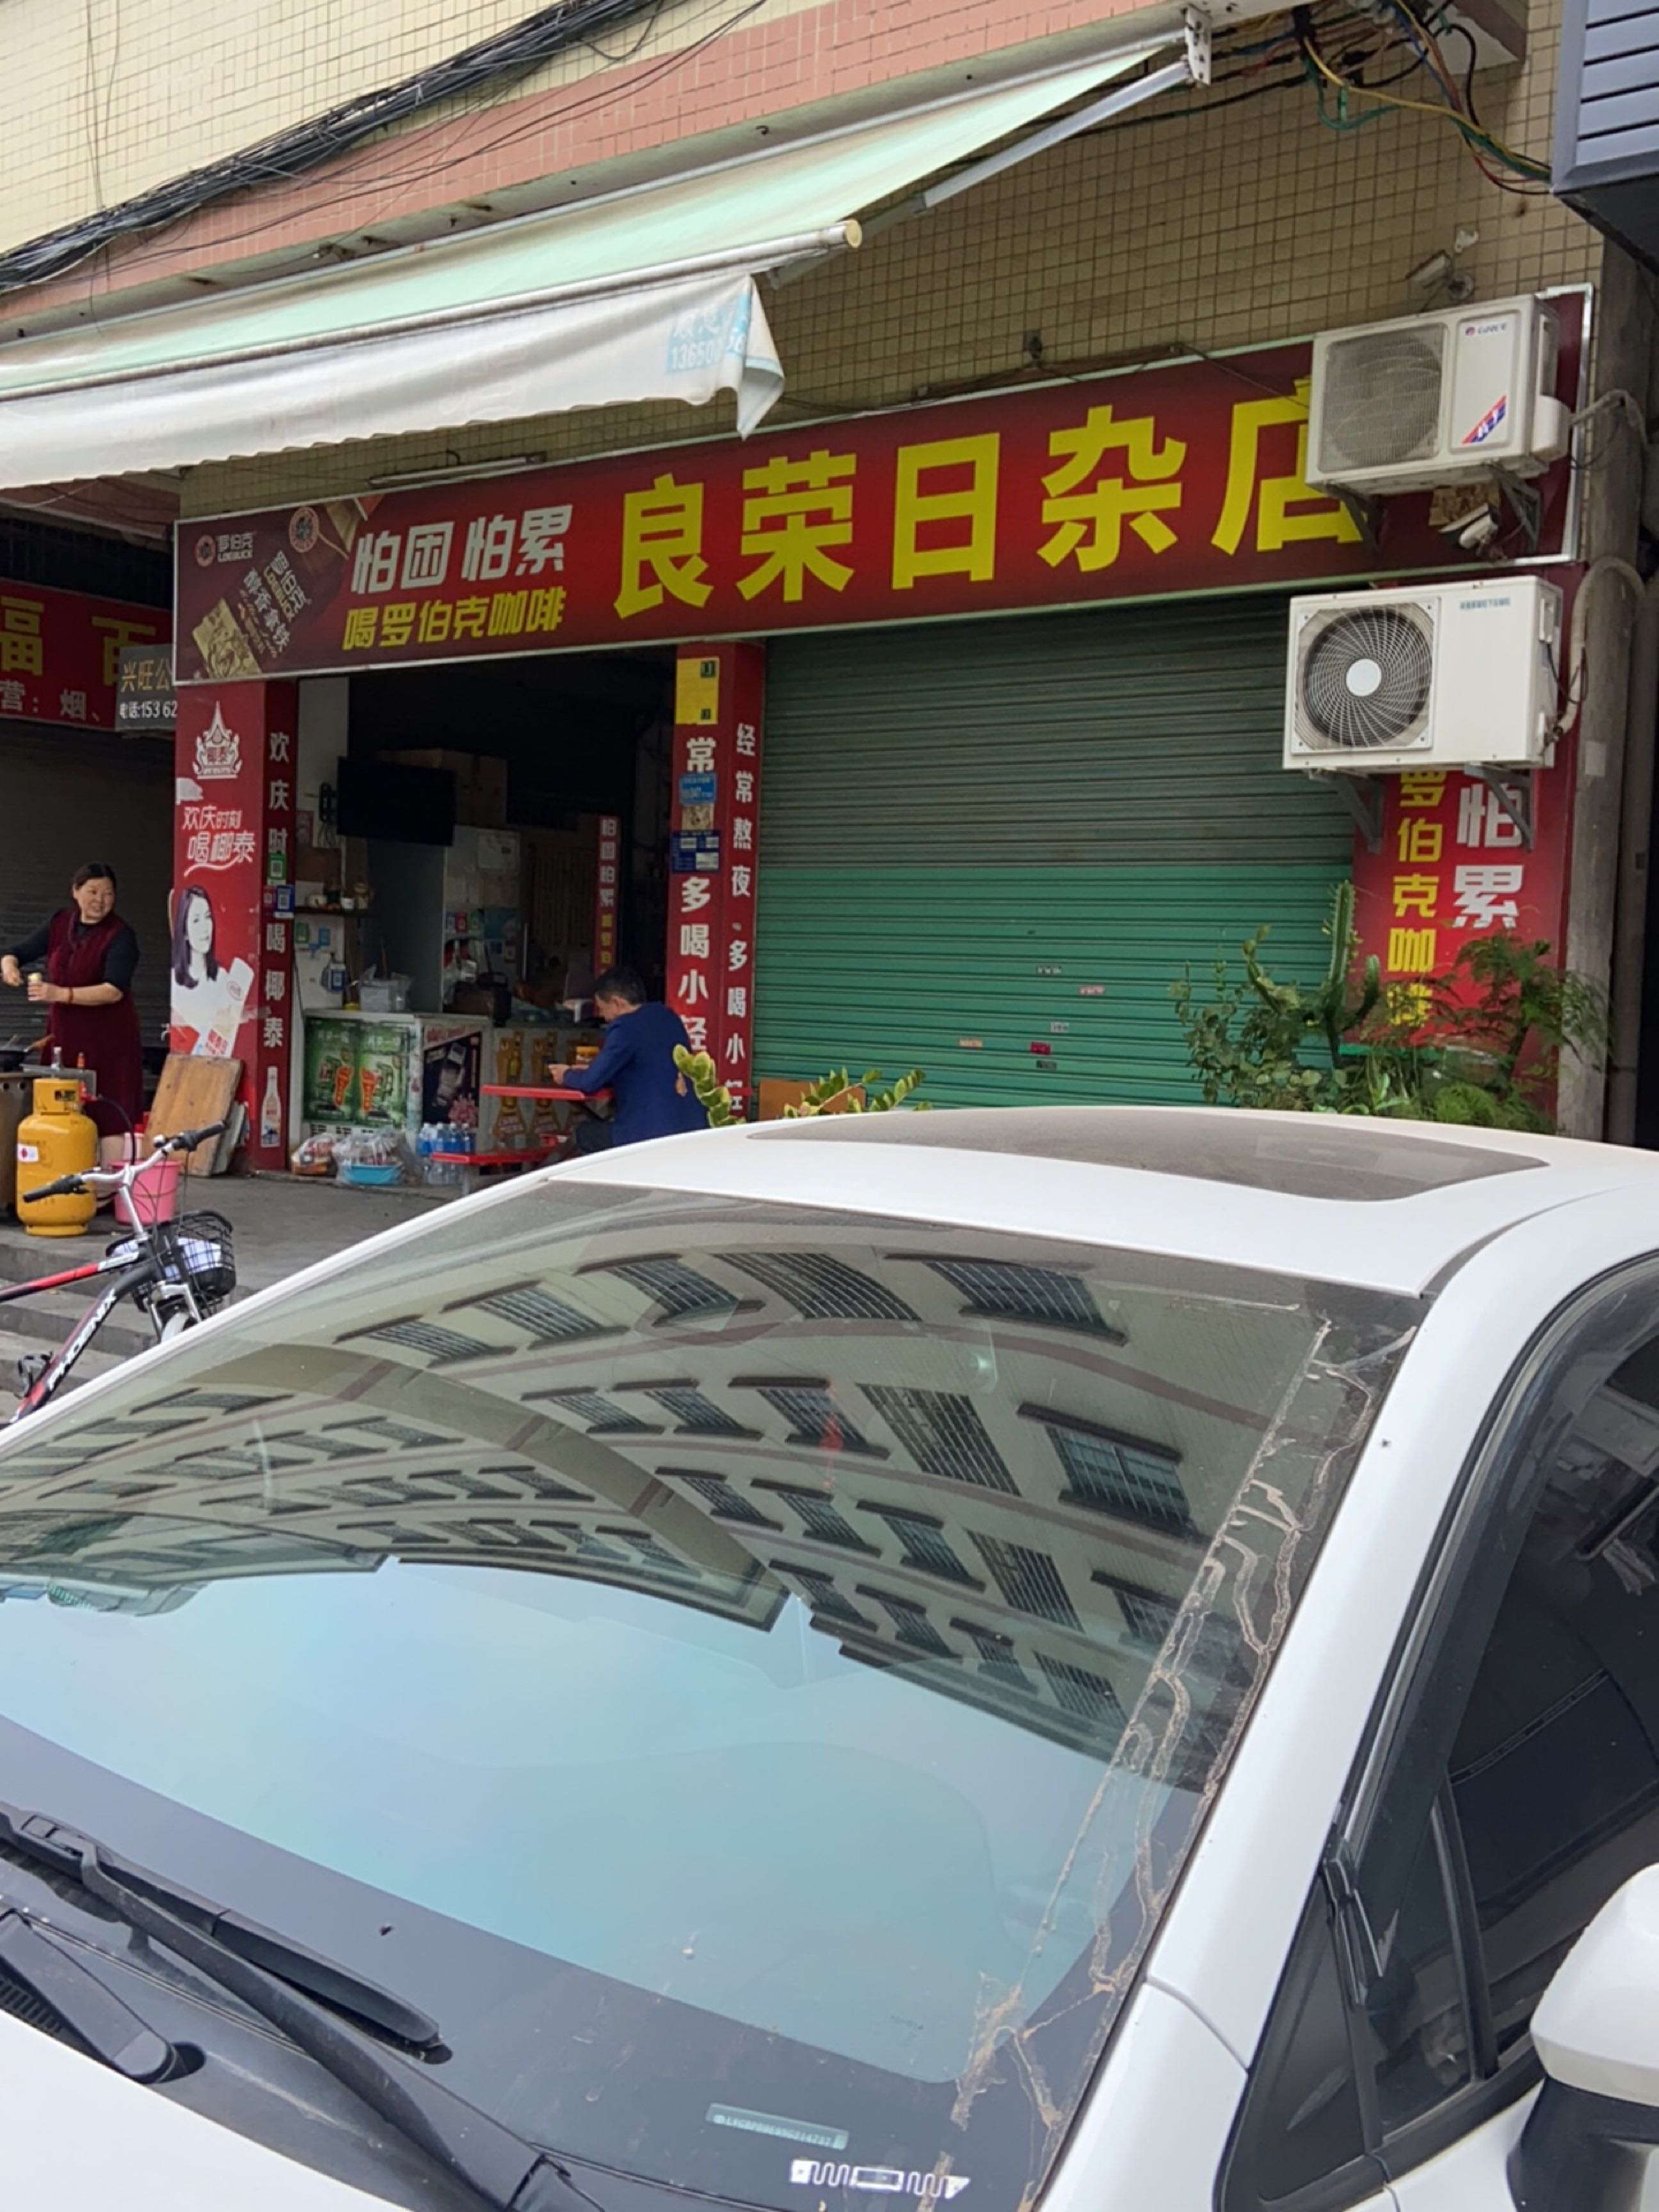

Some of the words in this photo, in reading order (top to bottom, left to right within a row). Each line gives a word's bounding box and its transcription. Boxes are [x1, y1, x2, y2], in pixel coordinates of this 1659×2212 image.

[613, 378, 1364, 619] 良荣日杂店
[342, 586, 566, 650] 喝罗伯克咖啡
[182, 805, 242, 830] 欢庆时刻
[187, 830, 256, 863] 喝椰泰
[263, 732, 290, 1048] 欢庆时喝椰泰
